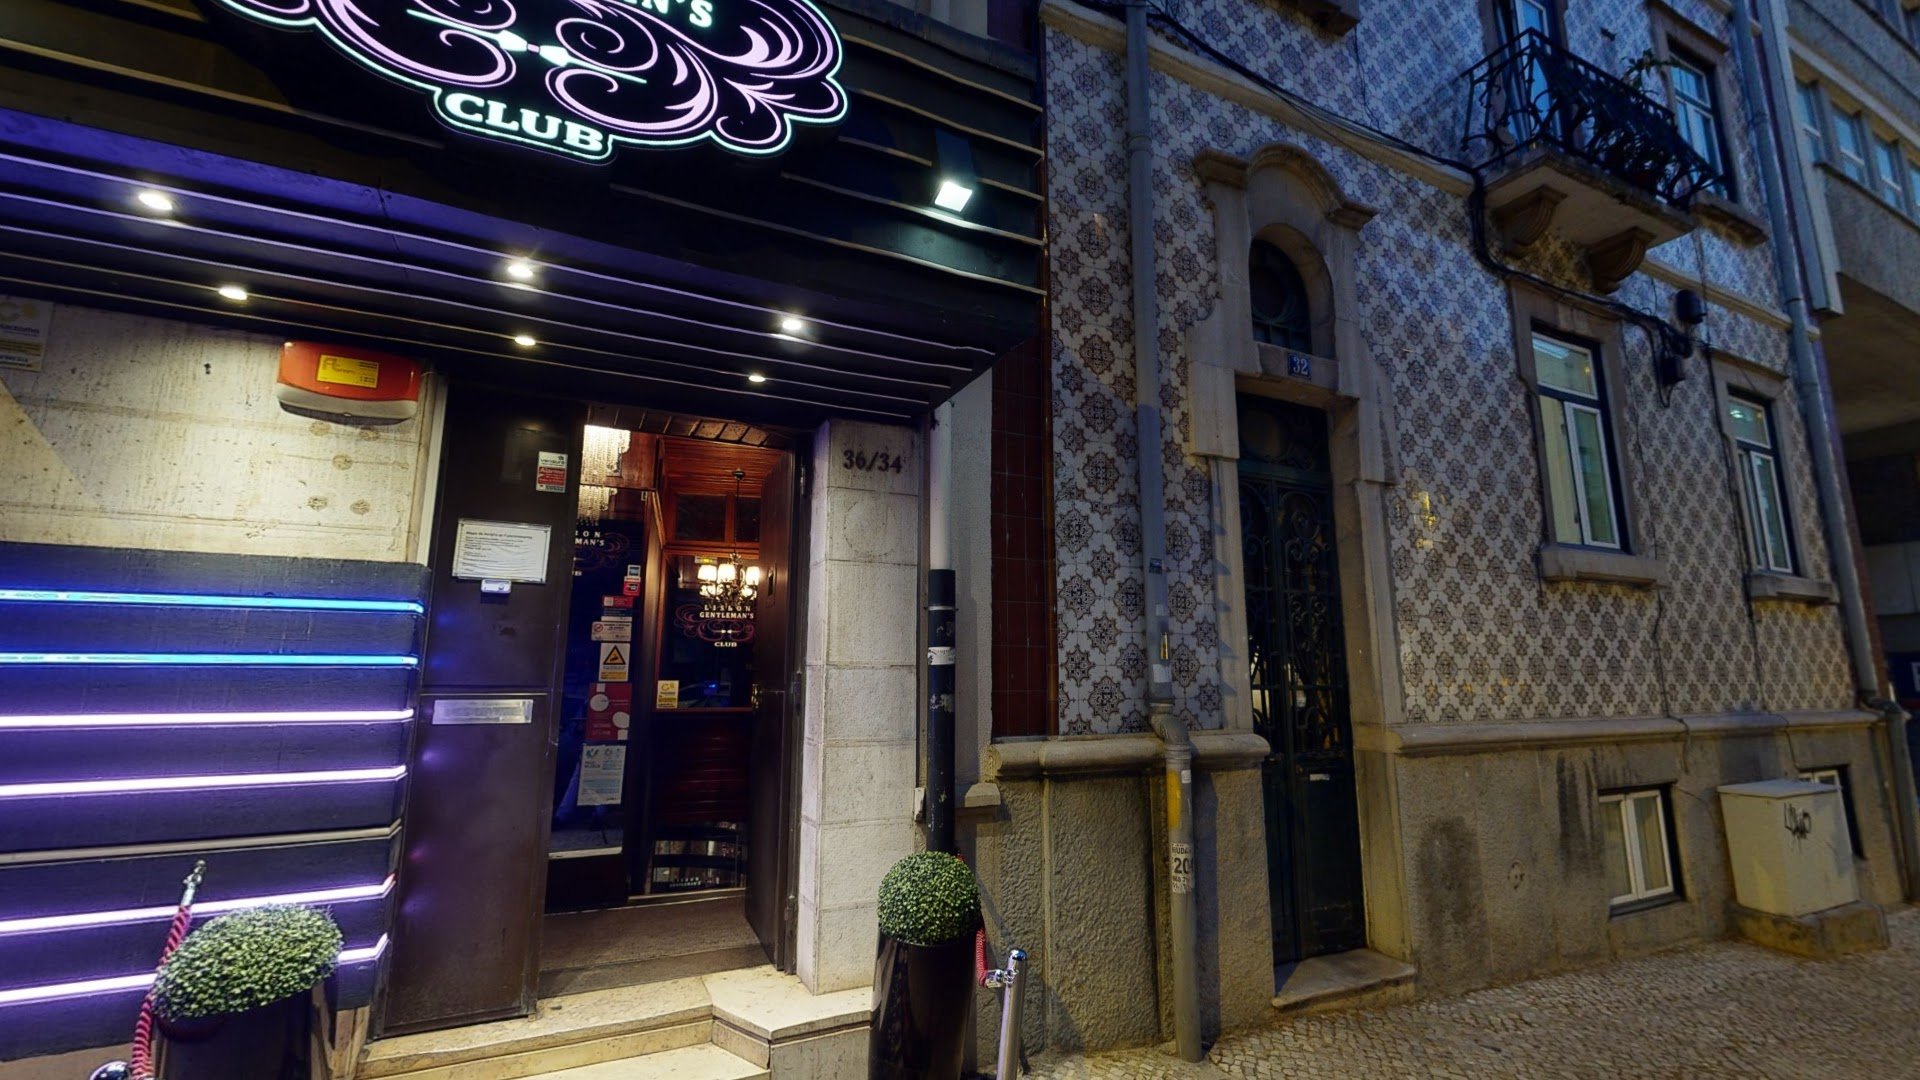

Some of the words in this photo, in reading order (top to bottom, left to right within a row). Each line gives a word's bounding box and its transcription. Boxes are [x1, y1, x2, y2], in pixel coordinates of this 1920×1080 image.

[445, 92, 604, 151] CLUB
[1293, 356, 1309, 375] 32
[842, 449, 903, 474] 36/34
[699, 611, 754, 619] GENTLEMAN'S
